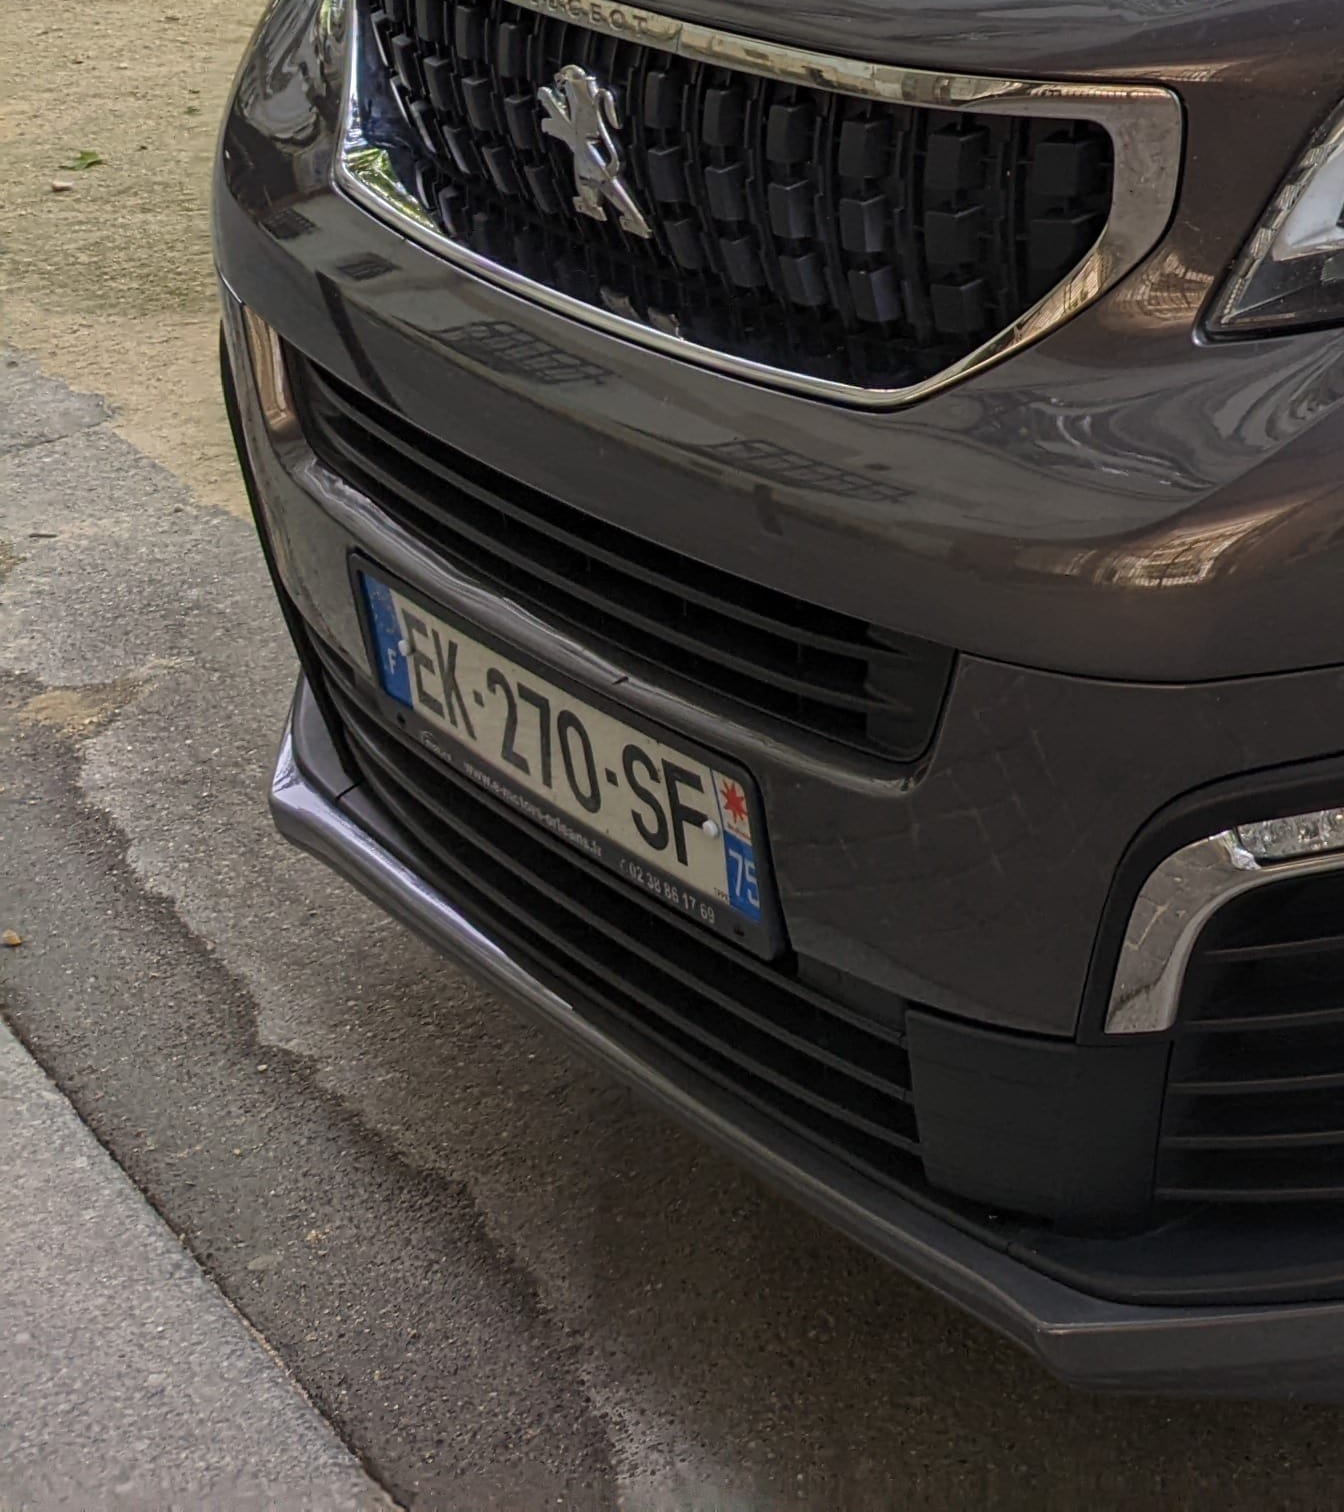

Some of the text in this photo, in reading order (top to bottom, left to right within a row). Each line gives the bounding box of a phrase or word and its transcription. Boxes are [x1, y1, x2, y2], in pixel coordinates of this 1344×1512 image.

[387, 647, 397, 675] F
[629, 862, 645, 884] 02
[683, 893, 697, 910] 17
[700, 903, 716, 924] 69
[728, 849, 761, 909] 75
